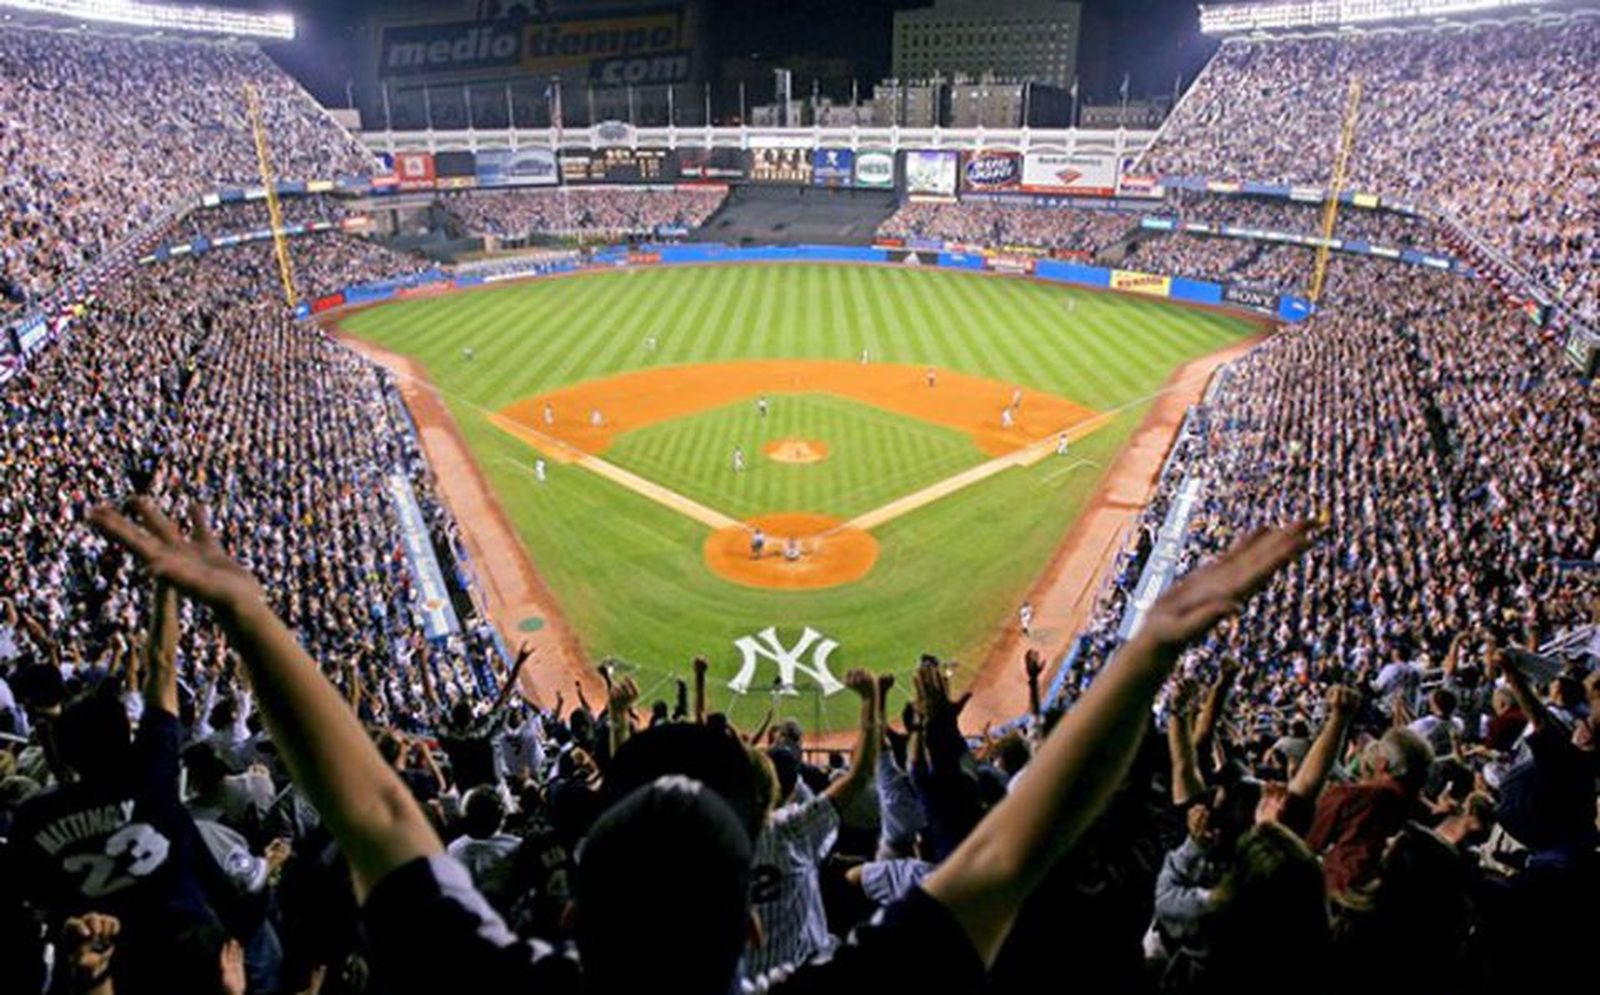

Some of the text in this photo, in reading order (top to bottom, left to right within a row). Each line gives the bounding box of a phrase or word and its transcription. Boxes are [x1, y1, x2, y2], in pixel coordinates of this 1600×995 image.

[387, 28, 517, 67] medio
[858, 162, 890, 175] HESS
[1227, 289, 1275, 307] SONY
[35, 797, 136, 855] MATTINGLY
[63, 824, 171, 899] 23
